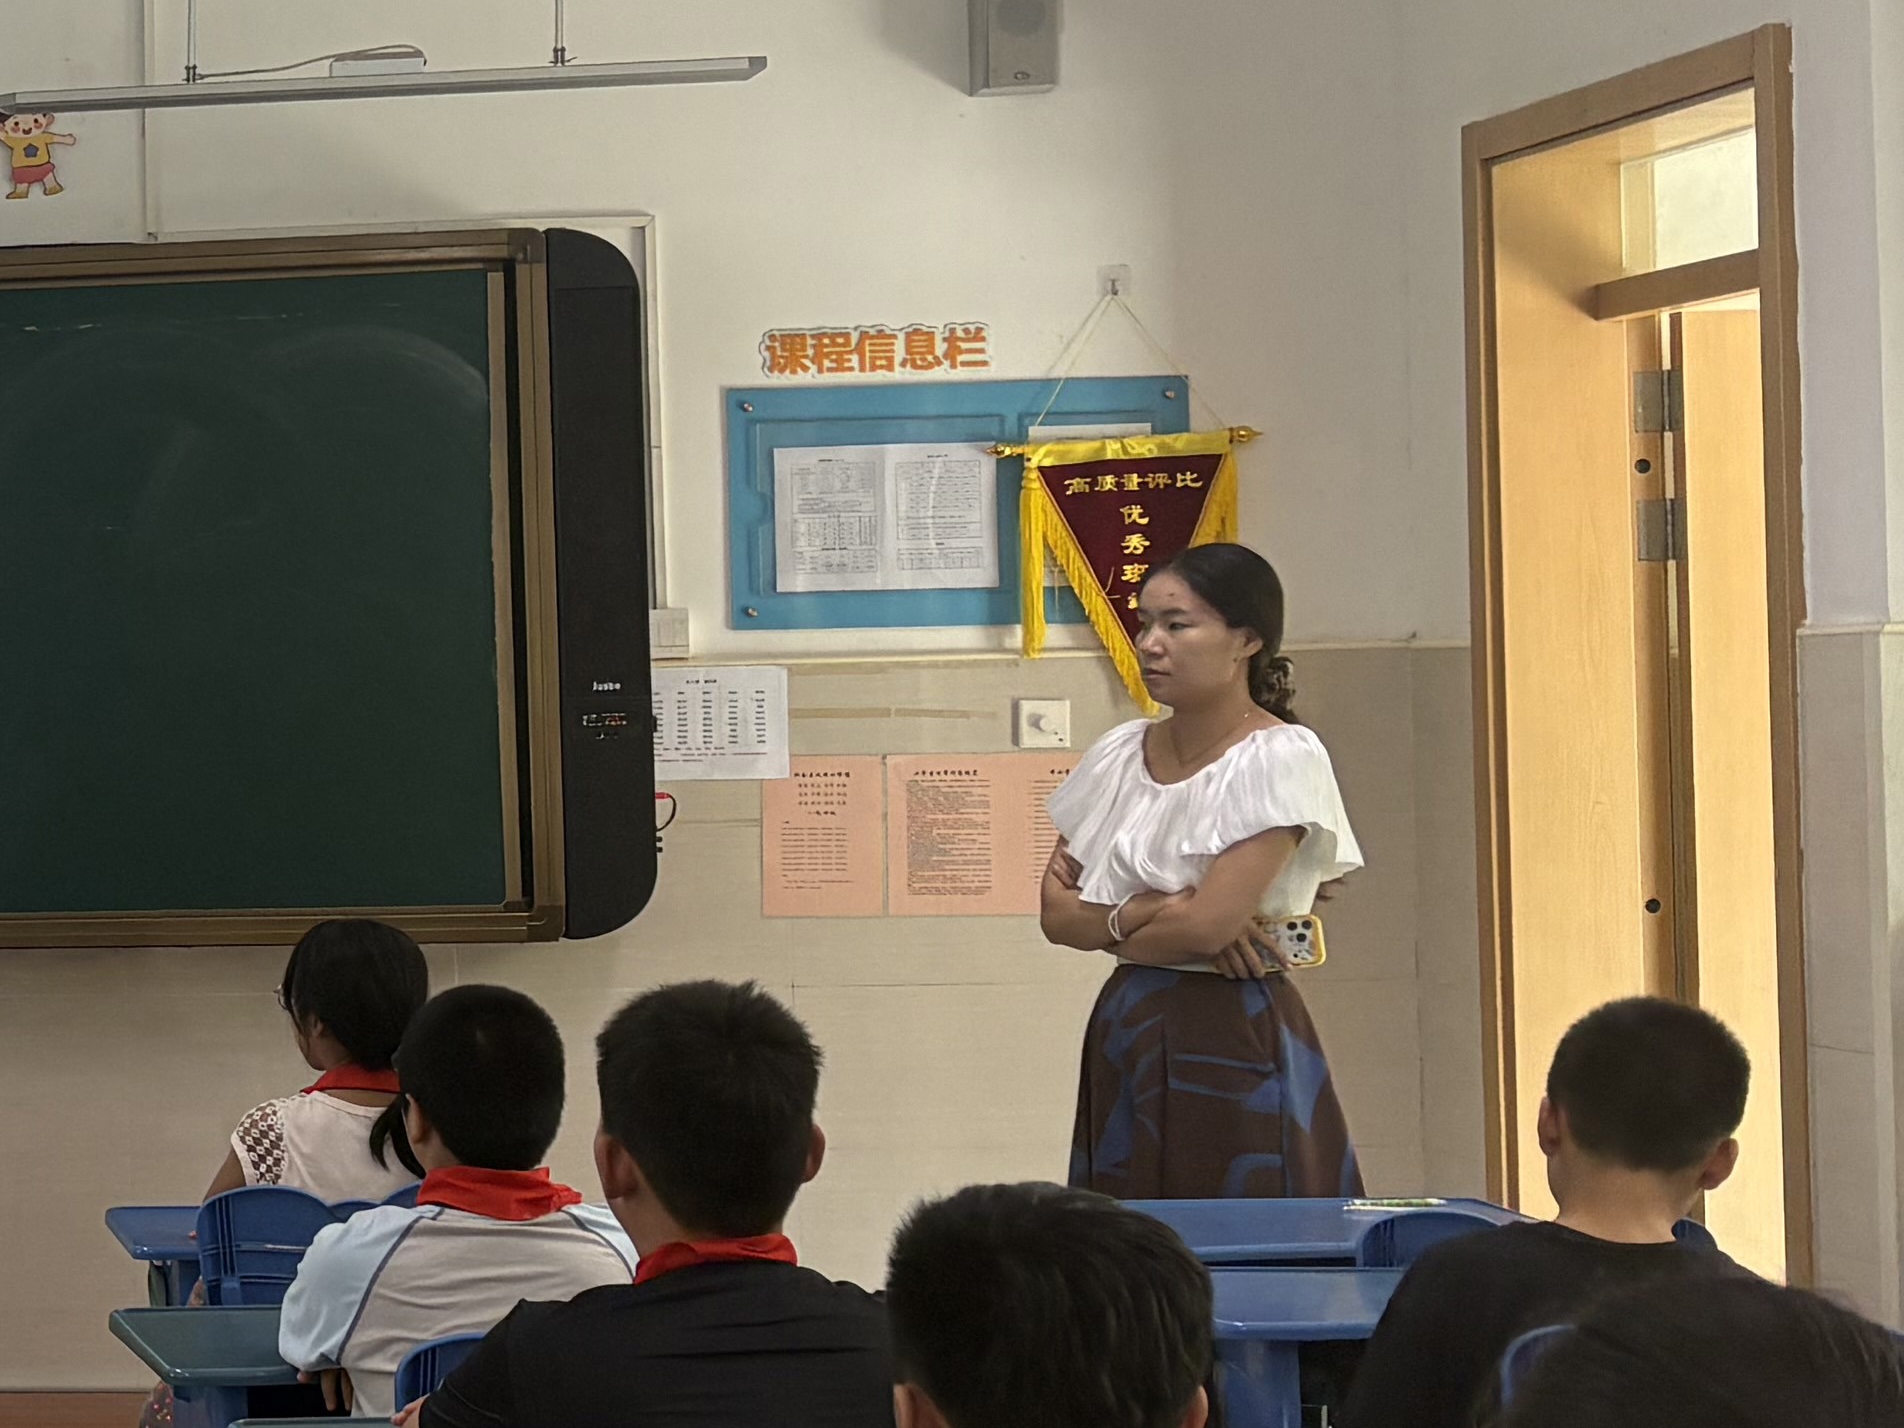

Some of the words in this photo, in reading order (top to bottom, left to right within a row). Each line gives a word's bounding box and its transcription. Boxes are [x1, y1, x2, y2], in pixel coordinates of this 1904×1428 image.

[766, 327, 990, 375] 课程信息栏
[1064, 472, 1203, 495] 高质量评比
